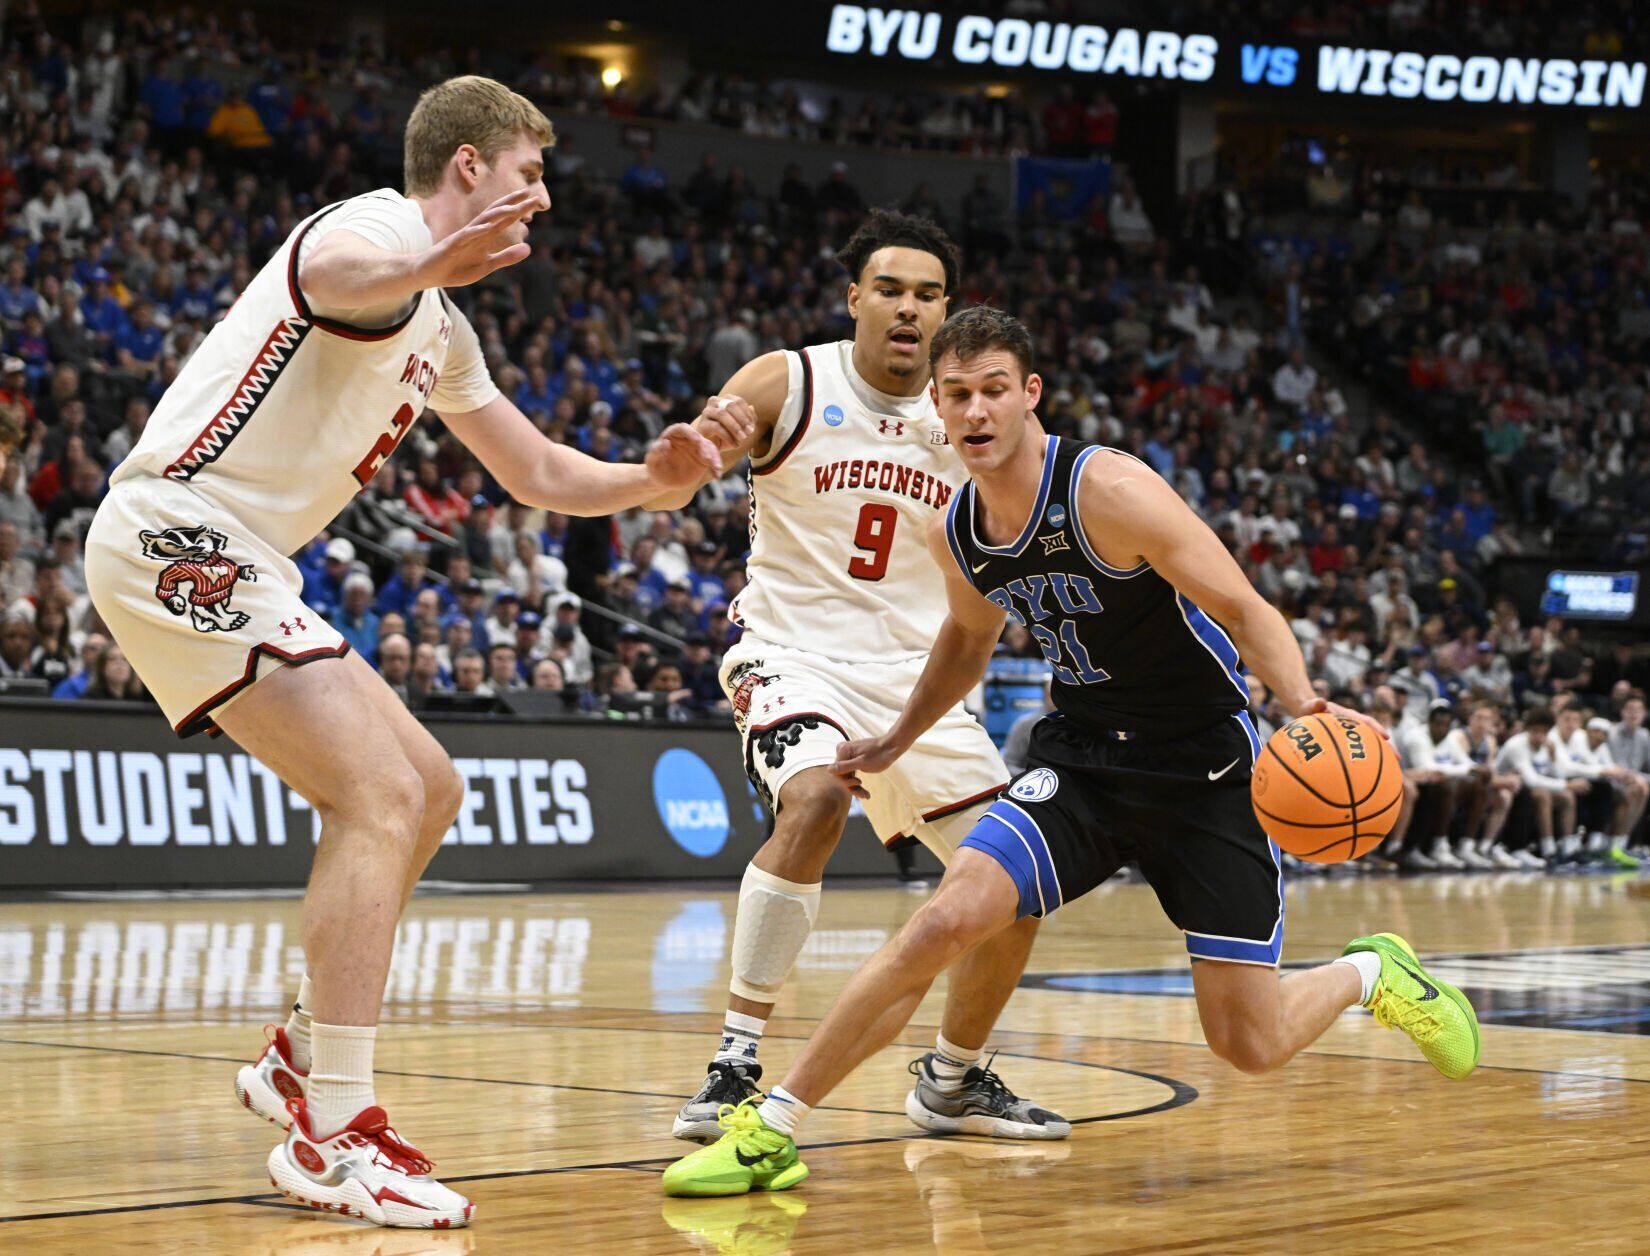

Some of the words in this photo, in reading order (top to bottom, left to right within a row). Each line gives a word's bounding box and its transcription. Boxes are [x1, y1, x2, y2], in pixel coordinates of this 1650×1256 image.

[827, 4, 942, 60] BYU
[953, 15, 1219, 82] COUGARS
[1240, 44, 1299, 86] VS
[1317, 45, 1648, 107] WISCONSIN
[351, 402, 414, 487] 2
[814, 459, 952, 510] WISCONSIN
[848, 502, 898, 582] 9
[985, 573, 1104, 627] BYU
[1031, 619, 1112, 686] 21
[666, 799, 730, 829] NCAA
